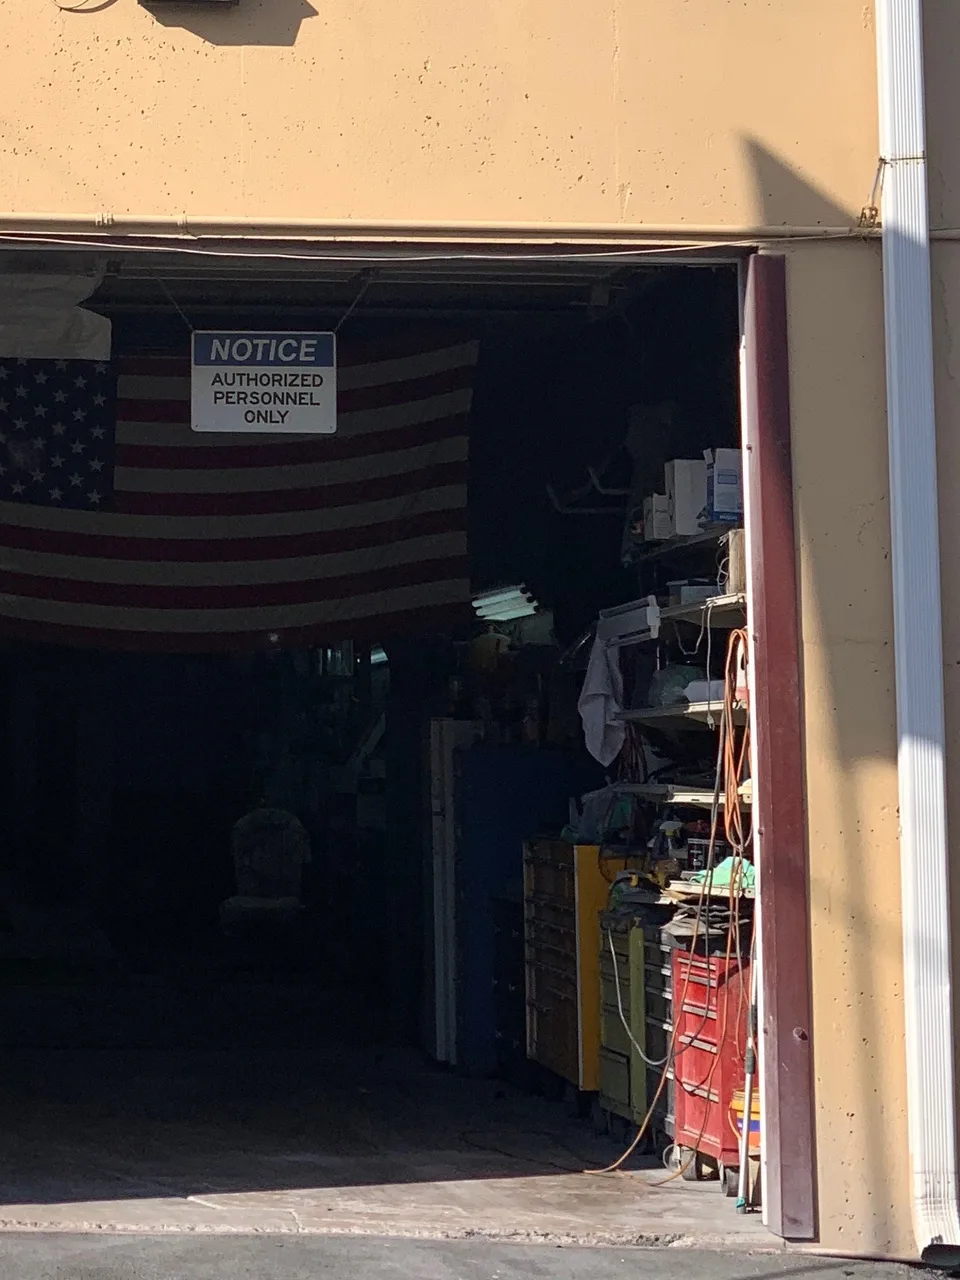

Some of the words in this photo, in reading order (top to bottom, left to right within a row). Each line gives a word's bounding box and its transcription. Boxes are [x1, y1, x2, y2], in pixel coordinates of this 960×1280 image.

[210, 338, 317, 361] NOTICE
[211, 373, 323, 387] AUTHORIZED
[214, 391, 320, 405] PERSONNEL
[244, 410, 289, 423] ONLY
